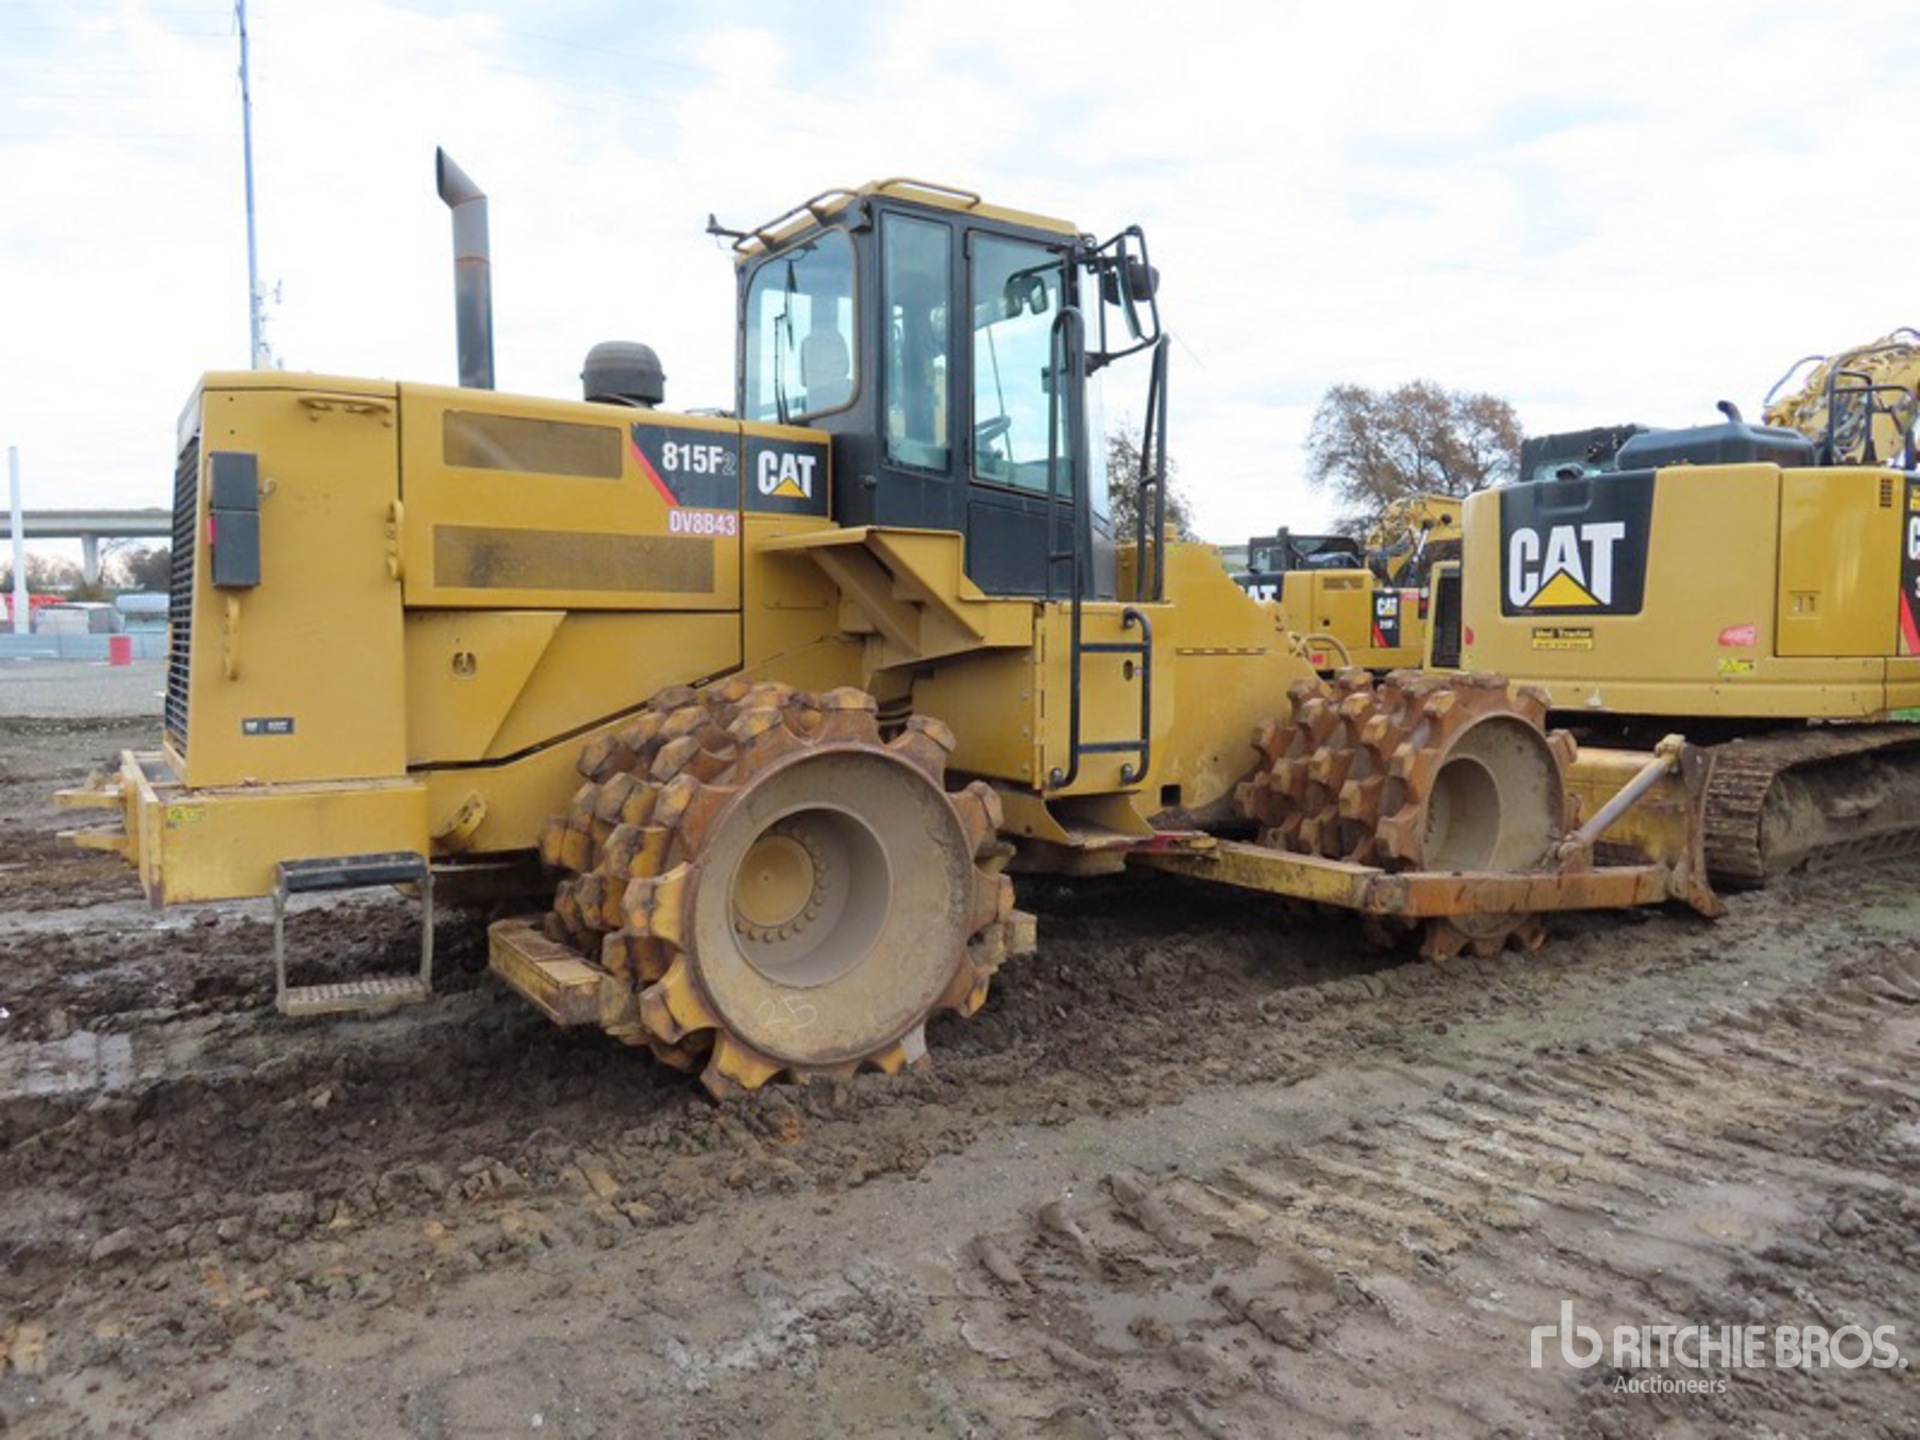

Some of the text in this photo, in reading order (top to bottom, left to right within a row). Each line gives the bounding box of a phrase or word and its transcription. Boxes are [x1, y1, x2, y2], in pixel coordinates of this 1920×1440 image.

[662, 441, 736, 476] 815F2
[758, 450, 816, 499] CAT
[669, 511, 736, 536] DV8B43
[1508, 521, 1626, 608] CAT
[1238, 585, 1278, 602] AT
[1377, 597, 1397, 616] CAT
